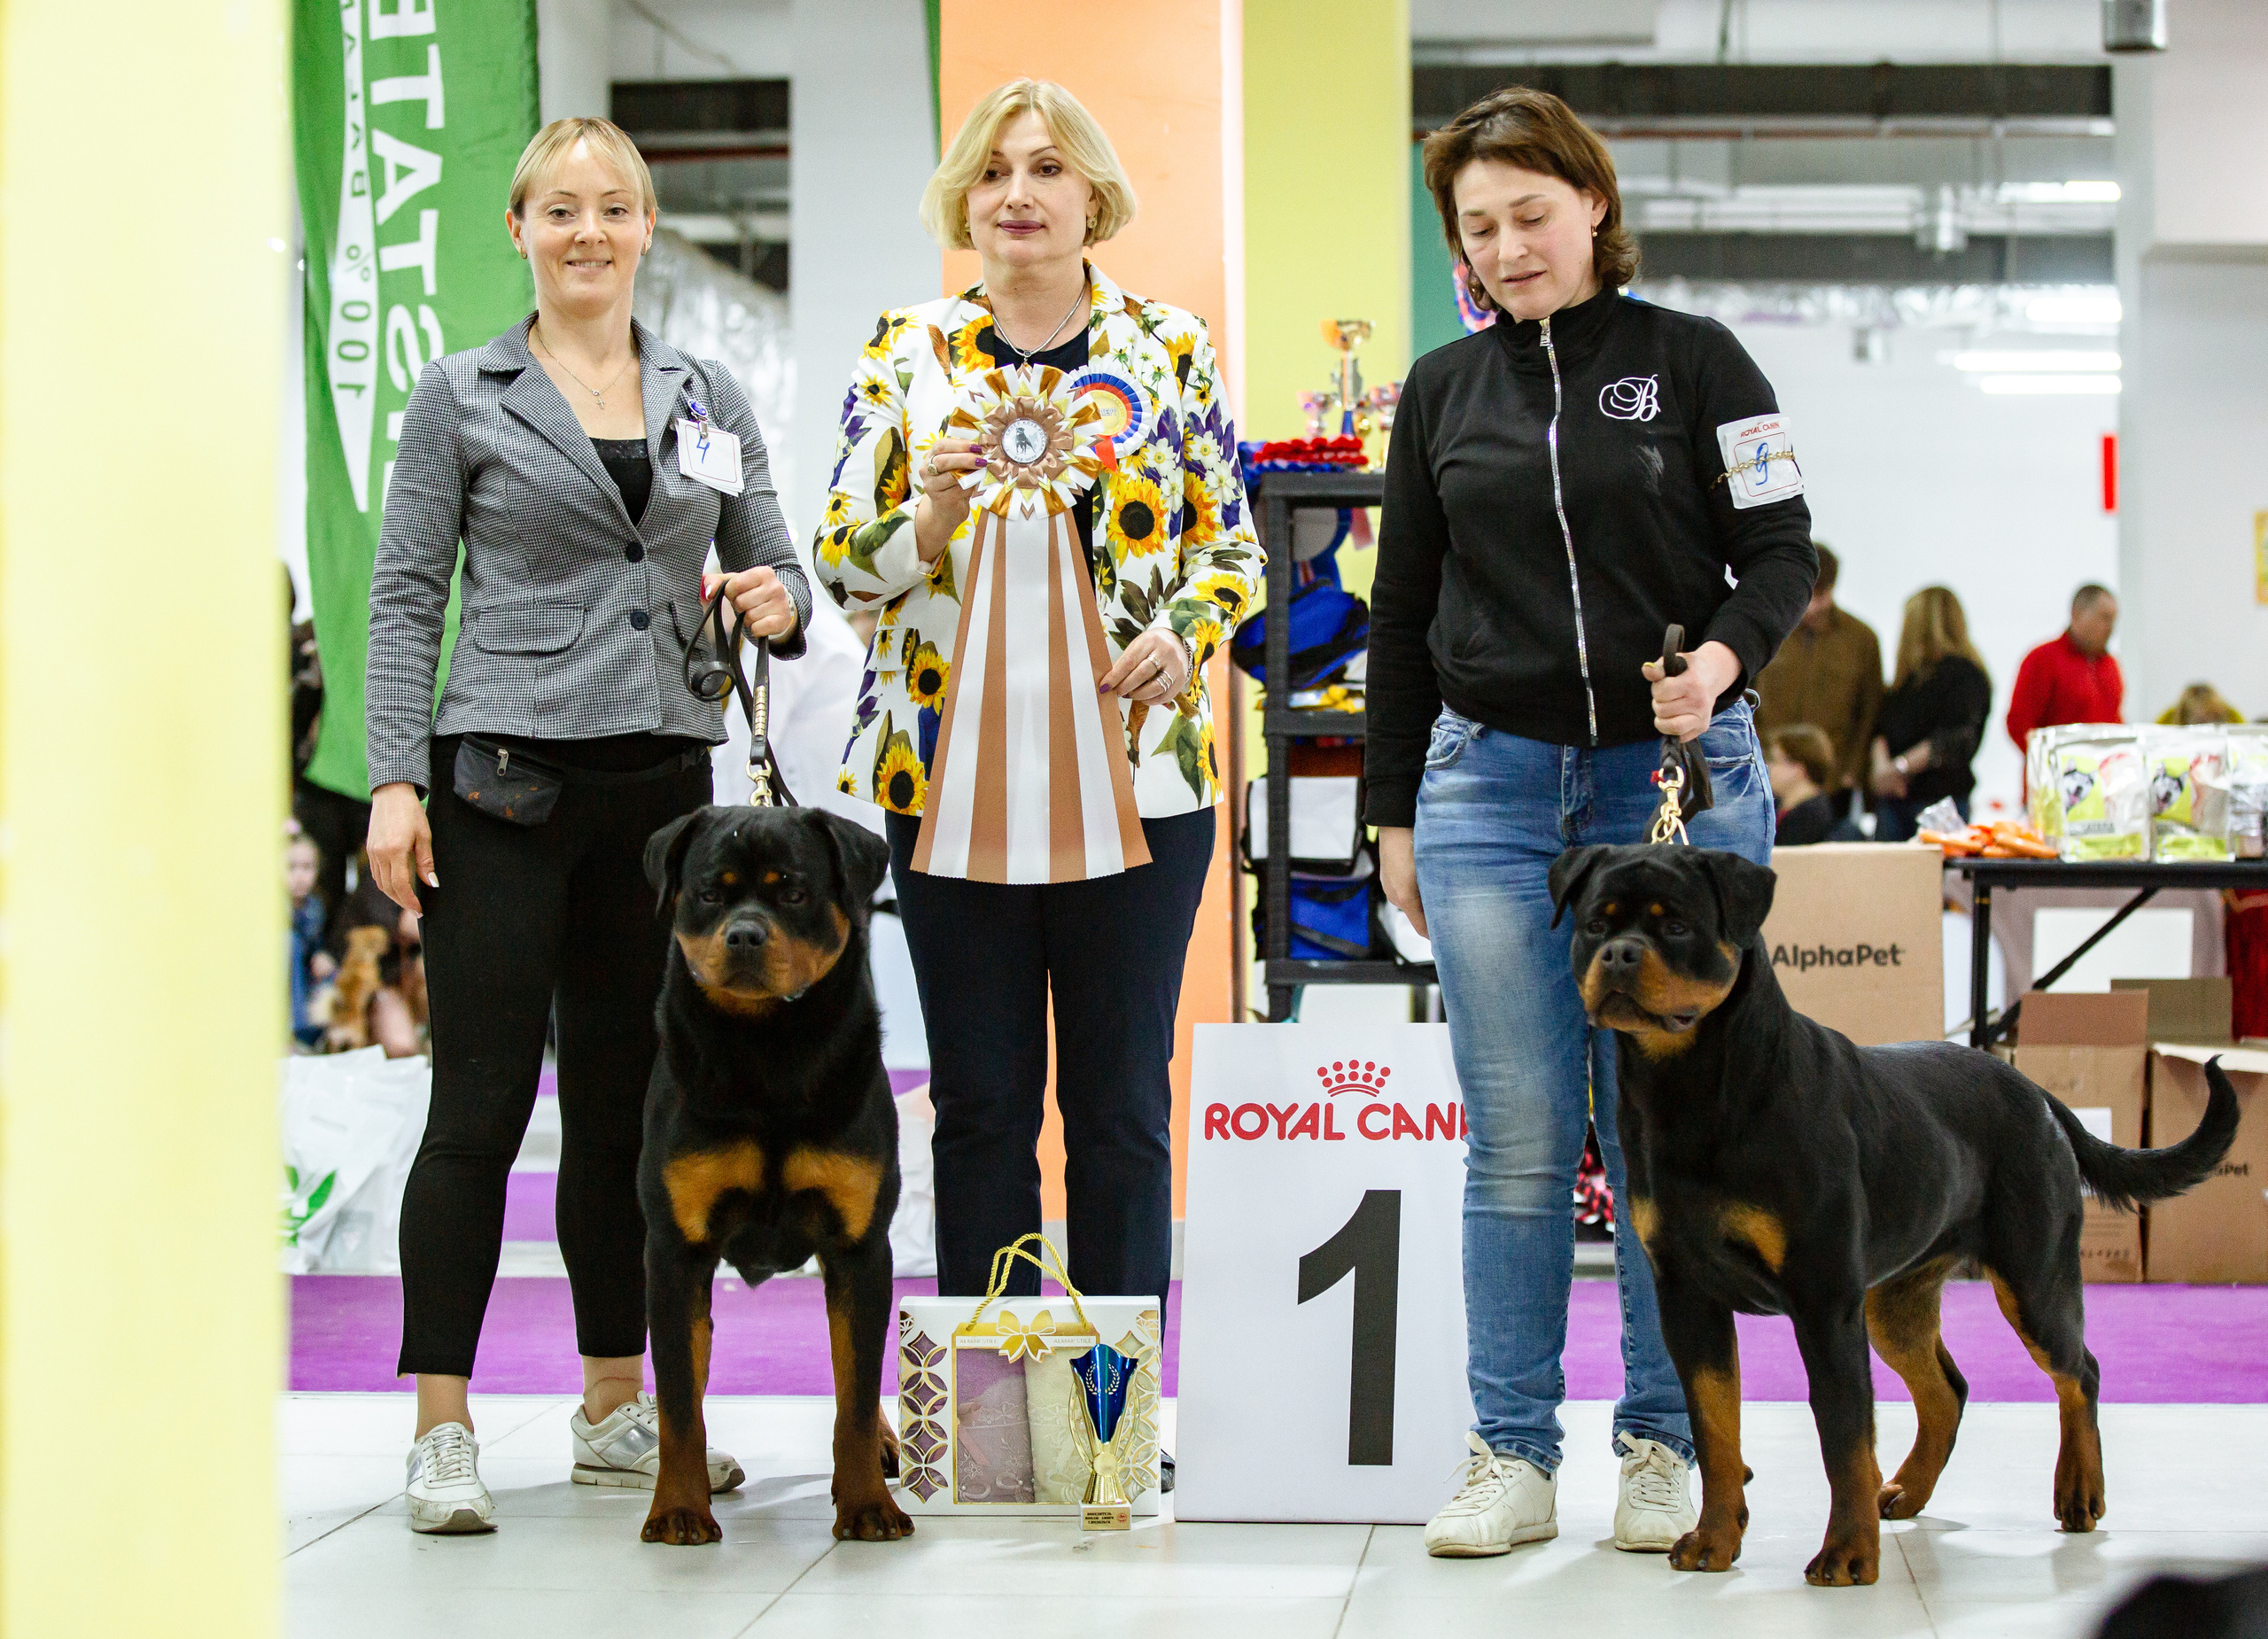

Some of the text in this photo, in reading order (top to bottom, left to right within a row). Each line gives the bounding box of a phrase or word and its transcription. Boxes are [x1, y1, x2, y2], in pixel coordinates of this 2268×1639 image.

[1740, 425, 1762, 438] ROYAL
[696, 437, 711, 464] 4
[1772, 944, 1902, 972] AlphaPet
[1204, 1101, 1468, 1141] ROYAL CANI
[1297, 1189, 1402, 1466] 1
